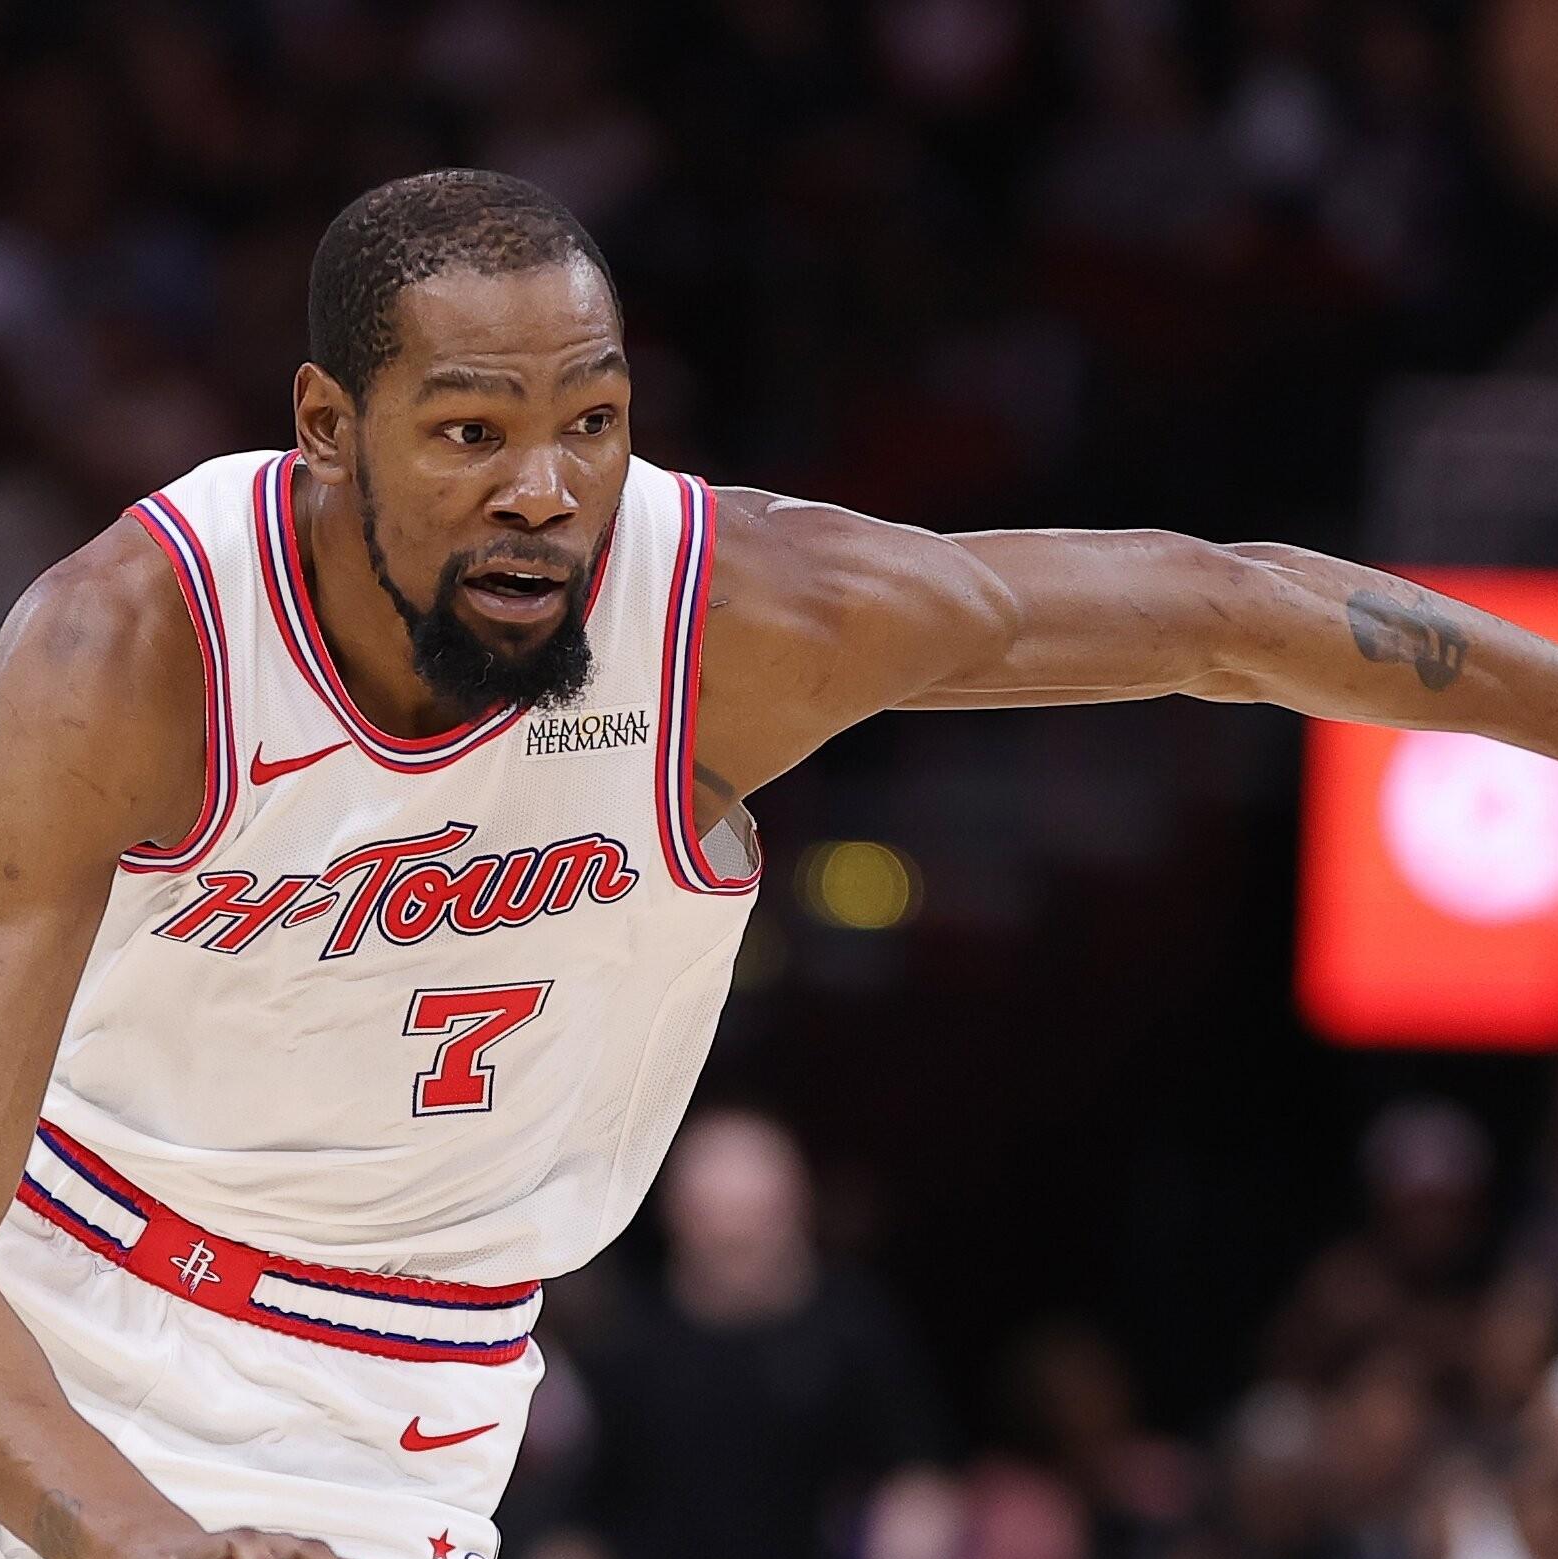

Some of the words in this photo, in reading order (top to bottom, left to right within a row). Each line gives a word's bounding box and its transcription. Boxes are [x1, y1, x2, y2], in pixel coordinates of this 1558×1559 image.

[525, 727, 648, 756] HERMANN
[527, 710, 650, 740] MEMORIAL
[151, 821, 639, 960] H-Town
[402, 979, 555, 1117] 7
